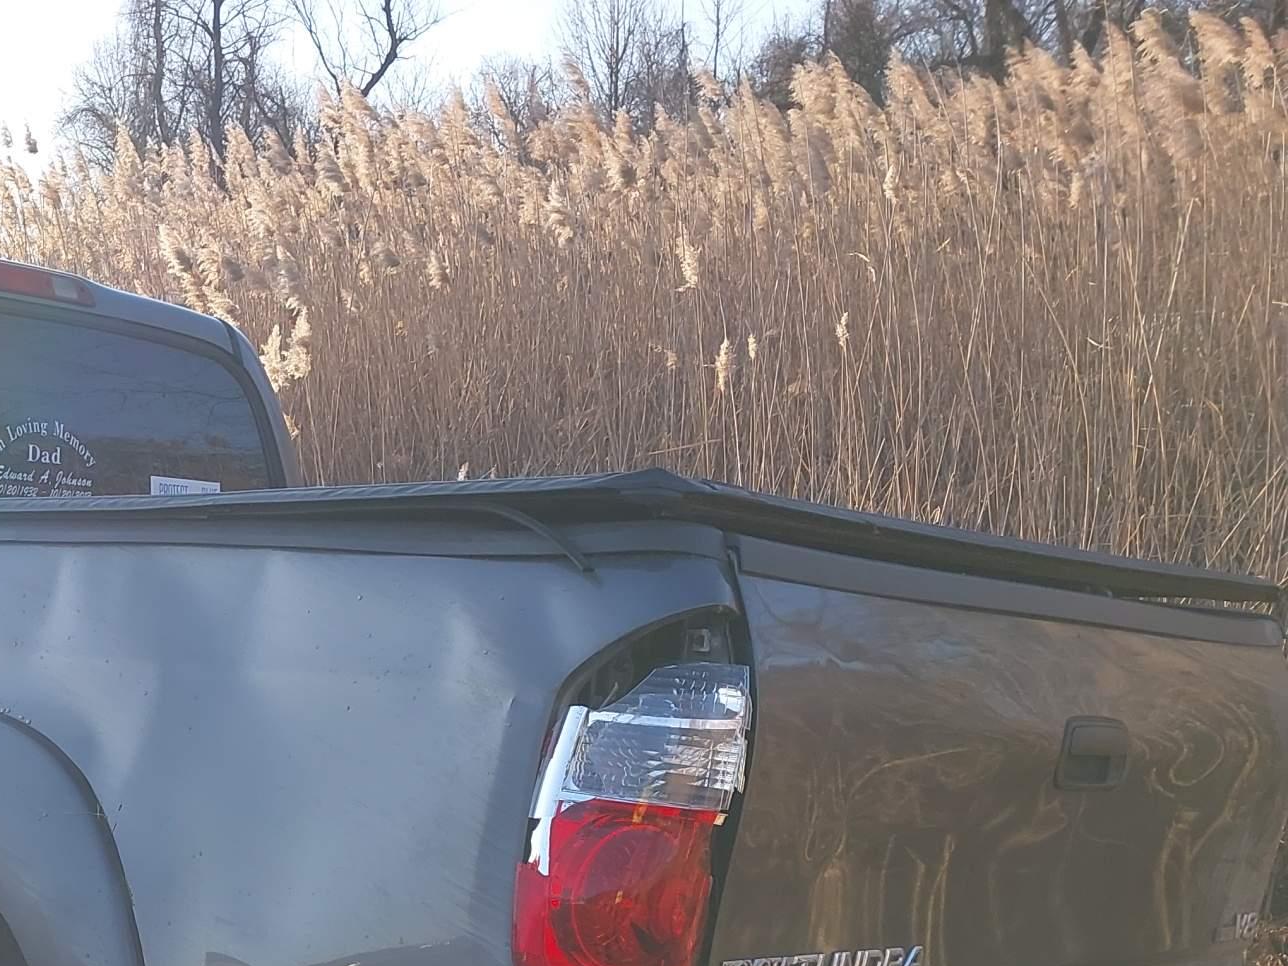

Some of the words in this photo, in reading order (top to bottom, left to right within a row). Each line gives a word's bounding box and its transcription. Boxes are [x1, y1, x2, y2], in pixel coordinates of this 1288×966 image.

[6, 417, 49, 441] Loving
[53, 420, 96, 467] Memory
[27, 443, 62, 465] Dad
[55, 471, 93, 489] Johnson
